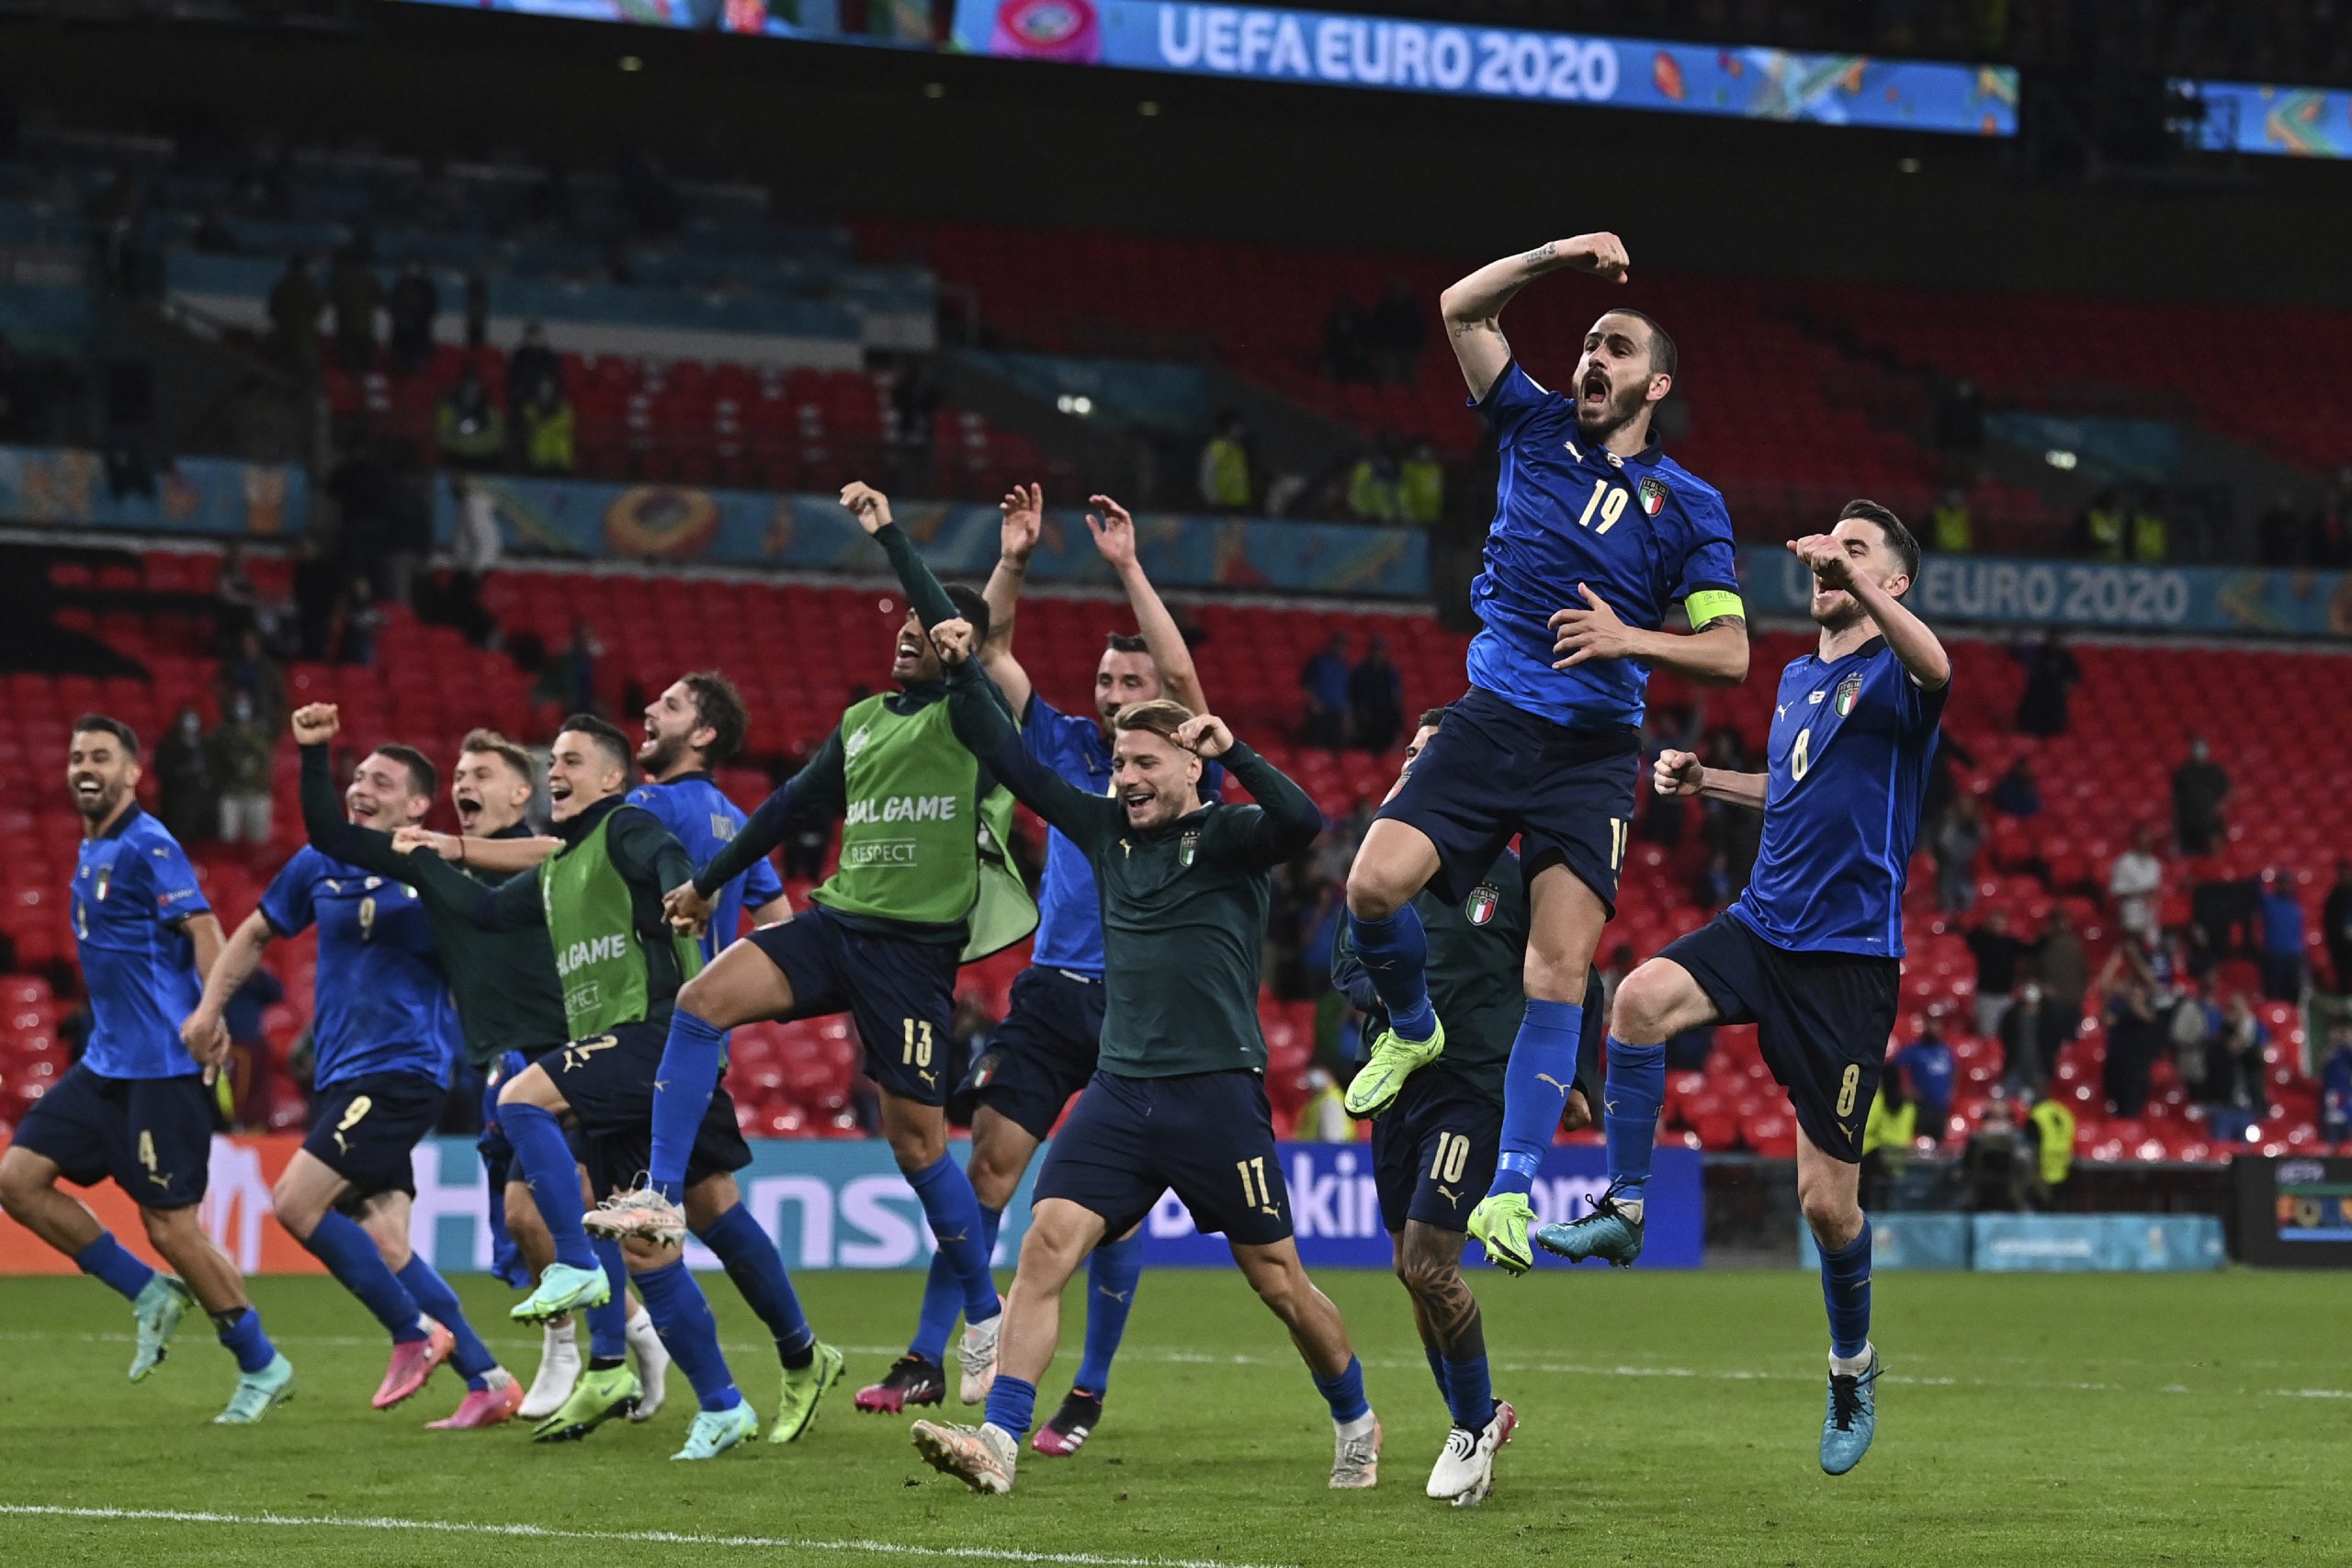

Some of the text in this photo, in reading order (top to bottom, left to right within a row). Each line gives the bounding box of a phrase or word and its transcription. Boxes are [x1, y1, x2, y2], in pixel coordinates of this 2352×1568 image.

[1159, 4, 1617, 100] UEFA EURO 2020
[1578, 479, 1628, 535] 19
[2064, 566, 2190, 623] 2020
[1792, 728, 1810, 781] 8
[883, 795, 956, 823] GAME
[852, 844, 916, 863] RESPECT
[1472, 888, 1498, 900] ITALIA
[570, 933, 626, 971] GAME
[902, 1018, 933, 1068] 13
[337, 1096, 372, 1131] 9
[1837, 1064, 1860, 1117] 8
[139, 1131, 157, 1172] 4
[1430, 1132, 1470, 1183] 10
[1236, 1156, 1270, 1208] 11
